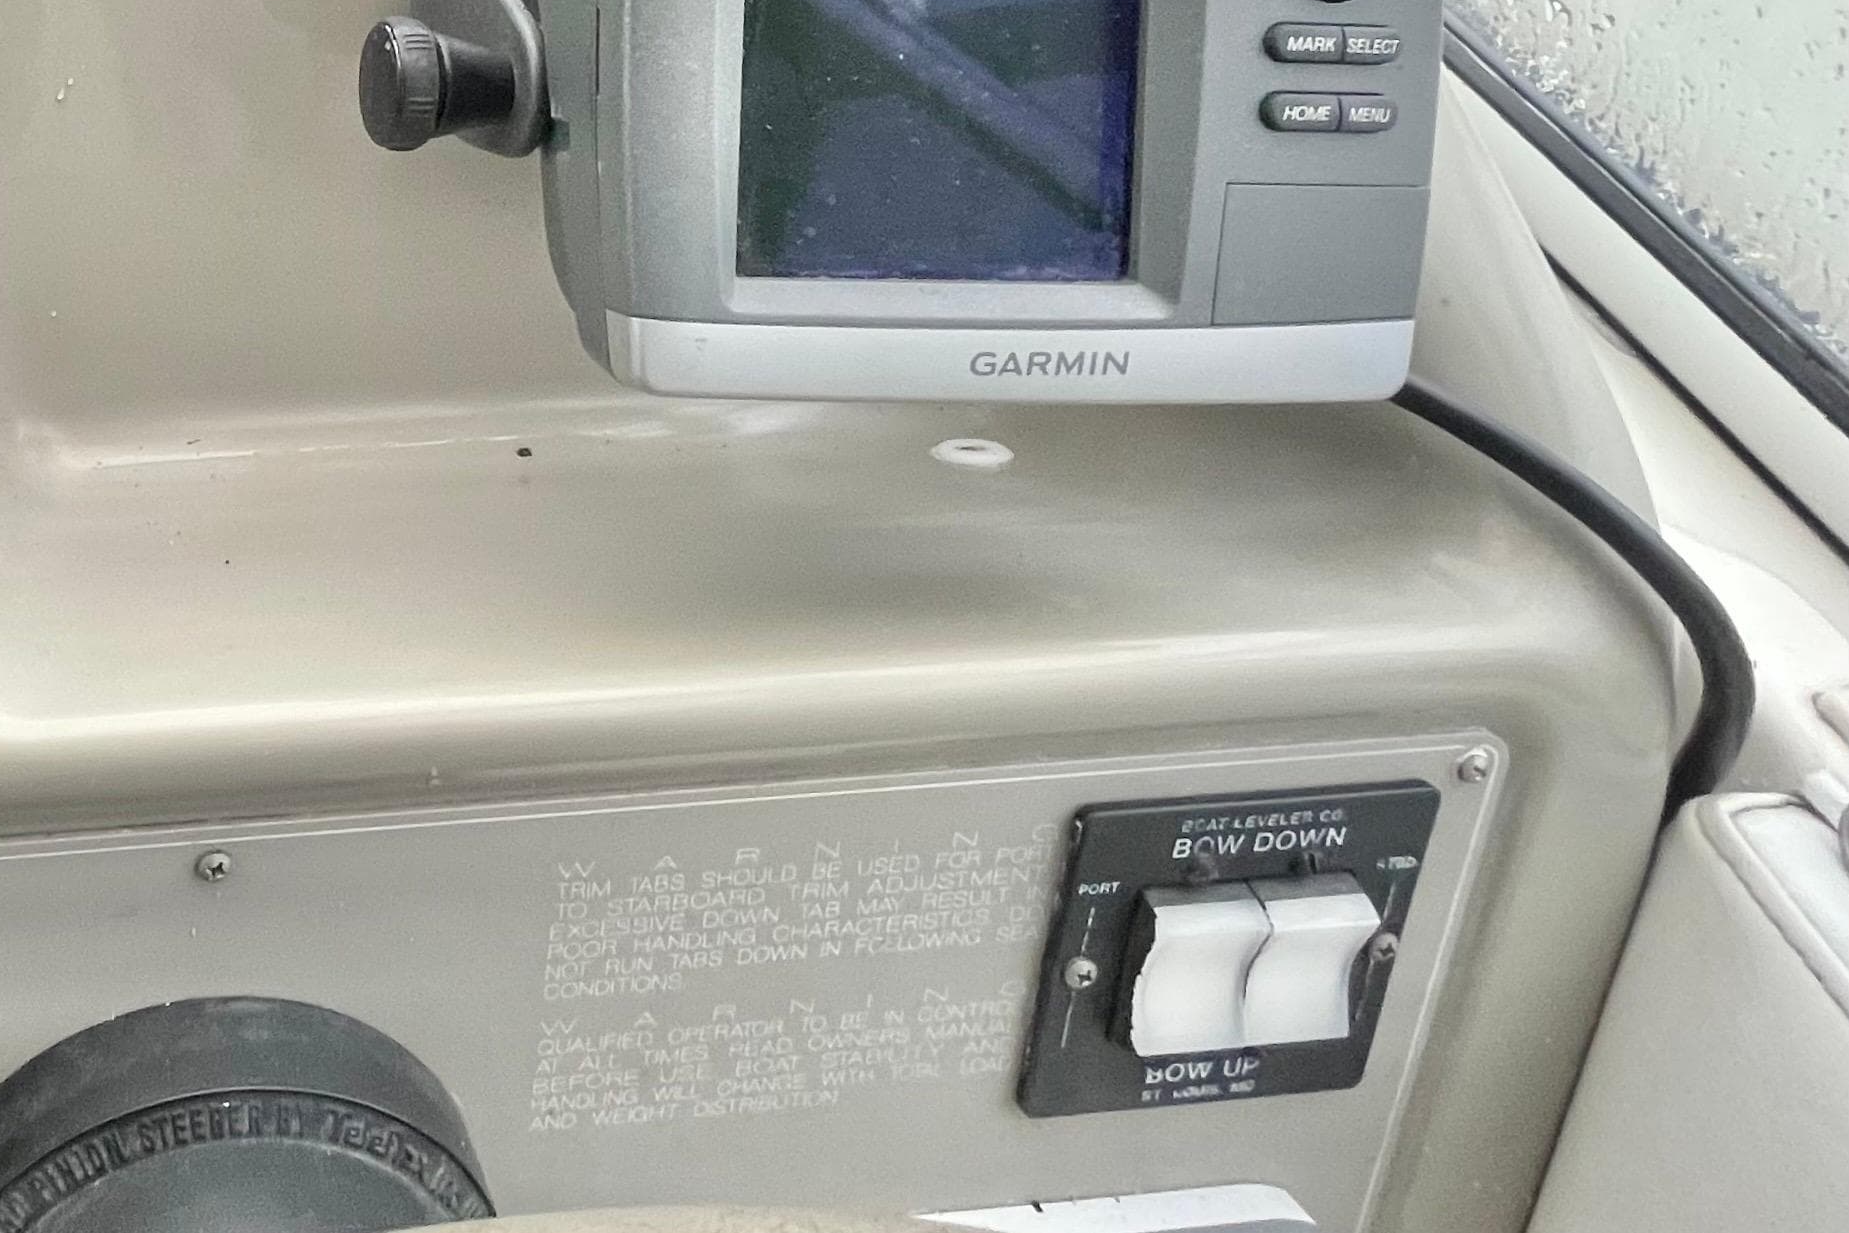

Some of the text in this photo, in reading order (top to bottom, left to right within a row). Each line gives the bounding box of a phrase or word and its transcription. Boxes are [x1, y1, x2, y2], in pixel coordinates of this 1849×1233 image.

[1286, 36, 1401, 55] MARK SELECT
[1282, 105, 1391, 124] HOME MENU
[968, 350, 1131, 377] GARMIN
[1233, 809, 1314, 829] LEVELER
[1171, 825, 1348, 860] BOW DOWN
[558, 878, 612, 901] TRIM
[631, 872, 686, 895] TABS
[702, 864, 798, 889] SHOULD
[811, 860, 843, 881] BE
[857, 853, 921, 876] USED
[935, 850, 981, 869] FOR
[1078, 880, 1121, 897] PORT
[557, 901, 588, 921] TO
[607, 886, 766, 917] STARBOARD
[790, 880, 849, 901] TRIM
[702, 906, 781, 930] DOWN
[802, 900, 841, 920] TAB
[856, 896, 904, 916] MAY
[921, 886, 1010, 910] RESULT
[546, 938, 617, 961] POOR
[633, 926, 756, 954] HANDLING
[771, 907, 991, 944] CHARACTERISTICS
[544, 923, 1039, 982] NOT RUN TABS DOWN IN FOLLOWING SEA
[543, 972, 683, 1001] CONDITIONS
[536, 1029, 653, 1057] QUALIFIED
[535, 1056, 559, 1075] AT
[1144, 1055, 1261, 1085] BOW UP
[532, 1068, 641, 1097] BEFORE
[530, 1086, 639, 1113] HANDLING
[529, 1110, 578, 1132] AND
[592, 1102, 682, 1126] WEIGHT
